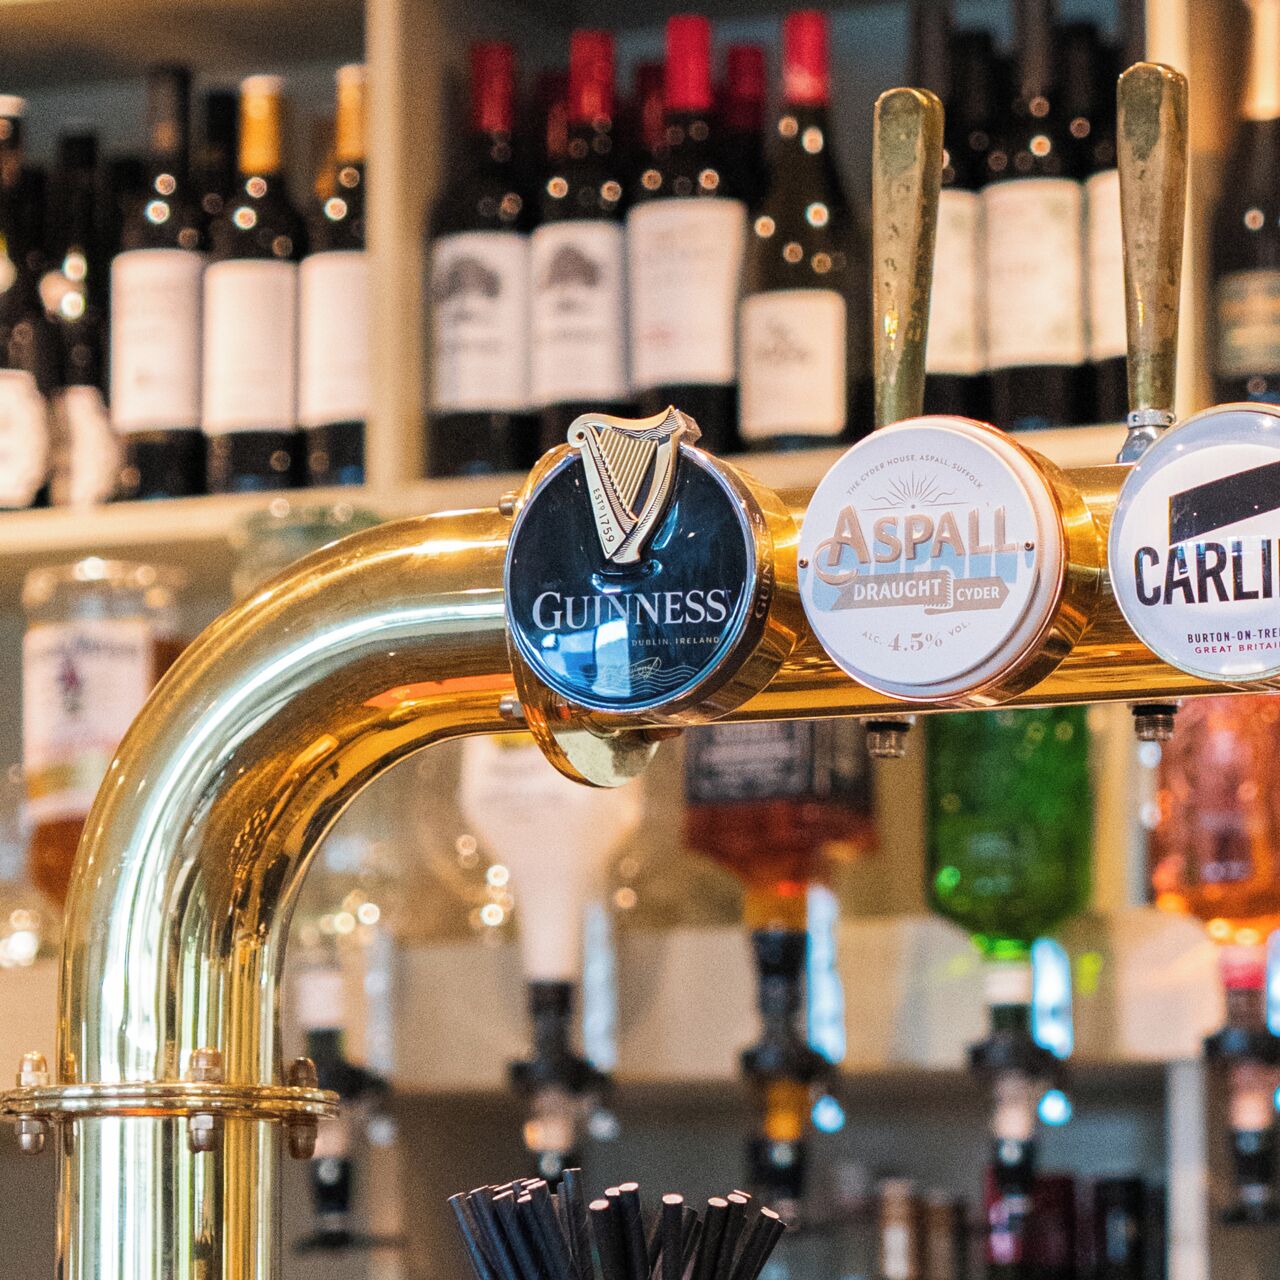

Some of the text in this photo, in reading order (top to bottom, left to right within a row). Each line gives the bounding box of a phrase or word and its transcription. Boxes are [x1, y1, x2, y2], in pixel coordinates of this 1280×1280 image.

[846, 480, 861, 495] THE
[861, 462, 886, 483] CYDER
[951, 463, 984, 489] SUFFOLK
[599, 513, 615, 542] 1759
[814, 505, 1017, 585] ASPALL
[853, 578, 1000, 601] DRAUGHT CYDER
[532, 589, 727, 631] GUINNESS
[675, 635, 720, 645] IRELAND
[887, 632, 944, 652] 4.5%
[1194, 645, 1233, 654] GREAT
